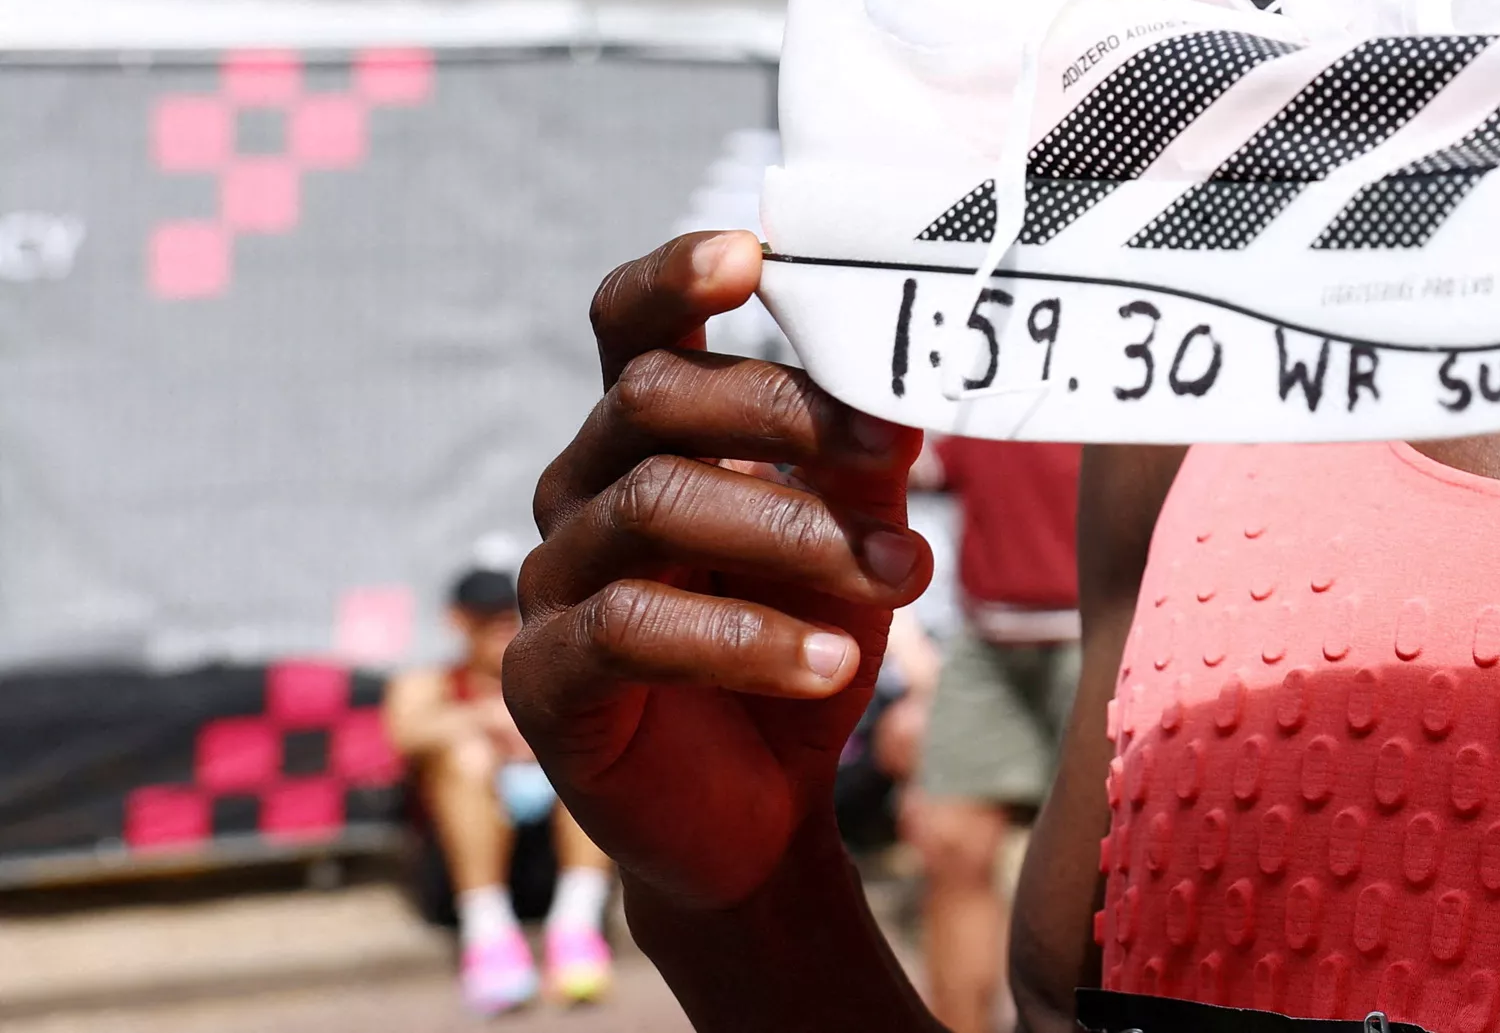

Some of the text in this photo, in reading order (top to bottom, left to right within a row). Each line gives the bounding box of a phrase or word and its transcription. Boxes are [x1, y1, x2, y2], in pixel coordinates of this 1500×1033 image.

[1062, 34, 1121, 93] ADIZERO
[892, 278, 1222, 400] 1:59.30
[1276, 325, 1381, 412] WR
